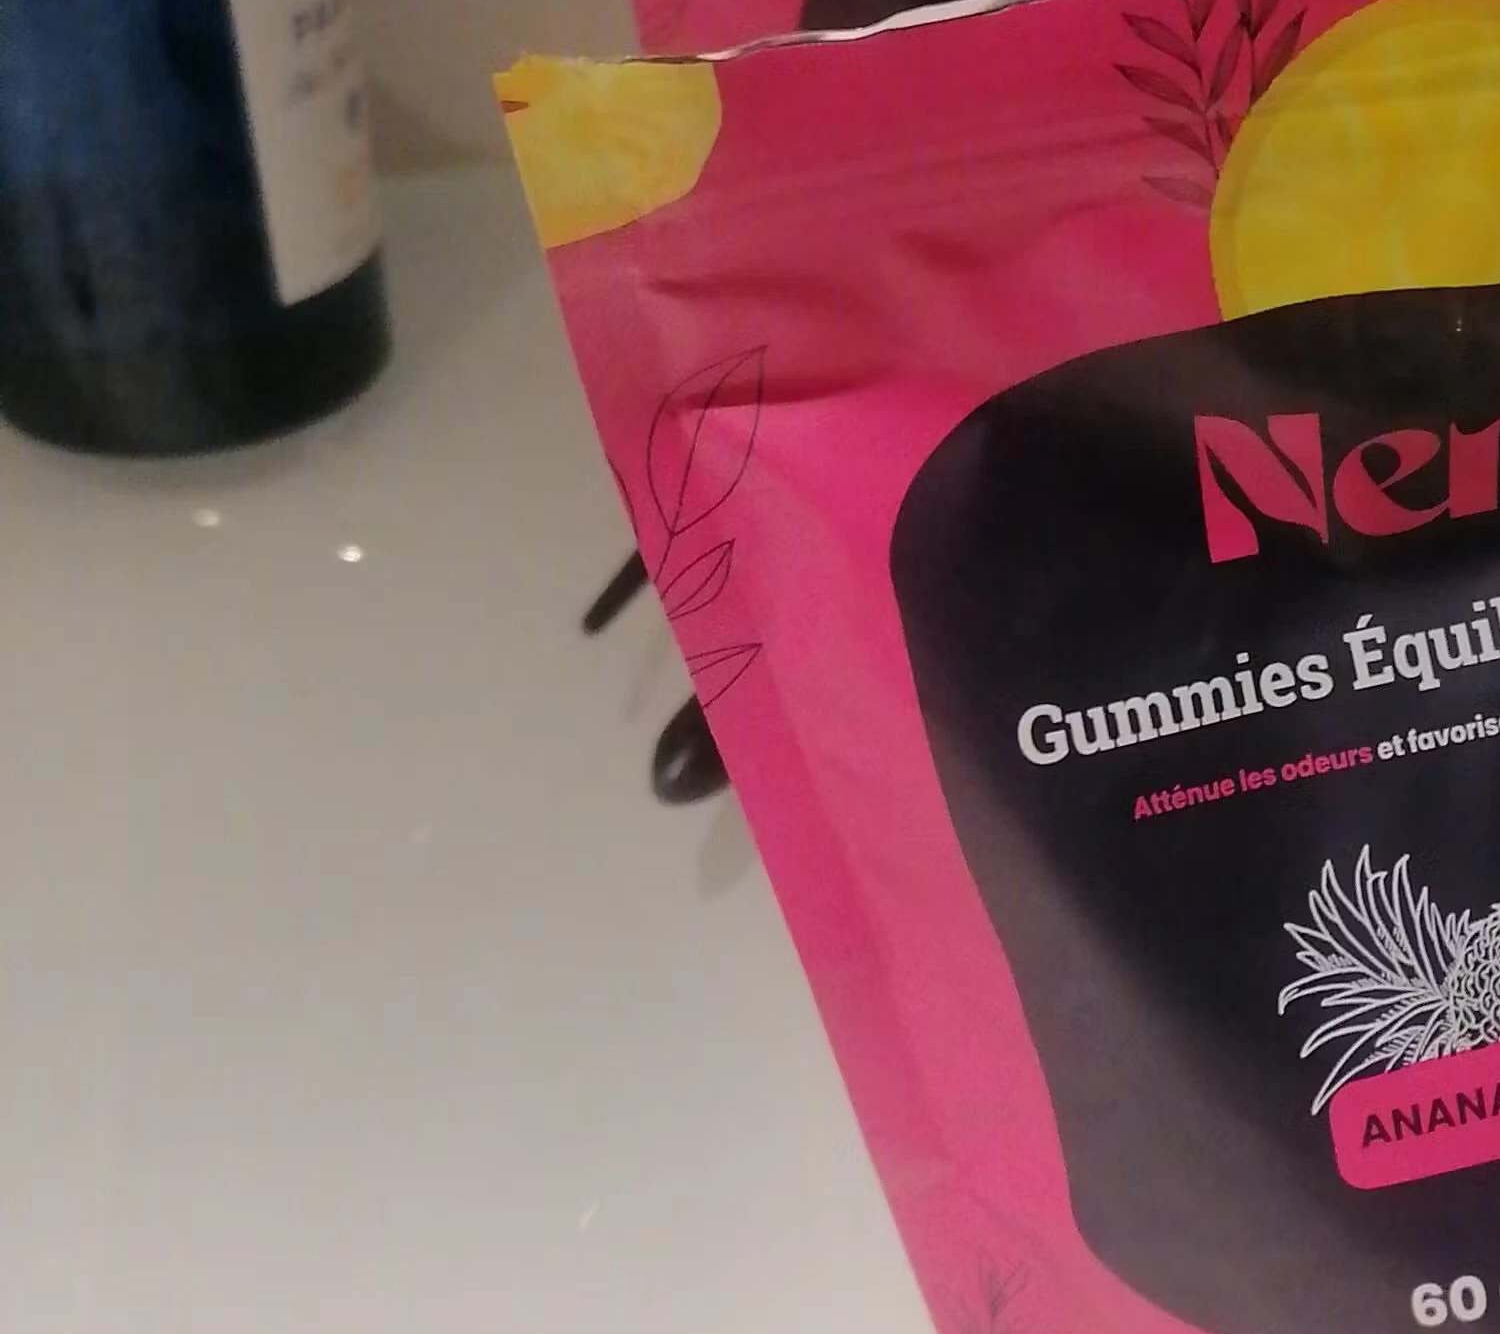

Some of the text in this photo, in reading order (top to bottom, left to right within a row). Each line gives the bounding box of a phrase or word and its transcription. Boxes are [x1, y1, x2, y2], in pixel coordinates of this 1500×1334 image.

[1017, 652, 1334, 766] Gummies
[1133, 777, 1235, 820] Atténue
[1239, 769, 1277, 794] les
[1281, 743, 1373, 780] odeurs
[1377, 729, 1407, 760] et
[1411, 1275, 1487, 1327] 60
